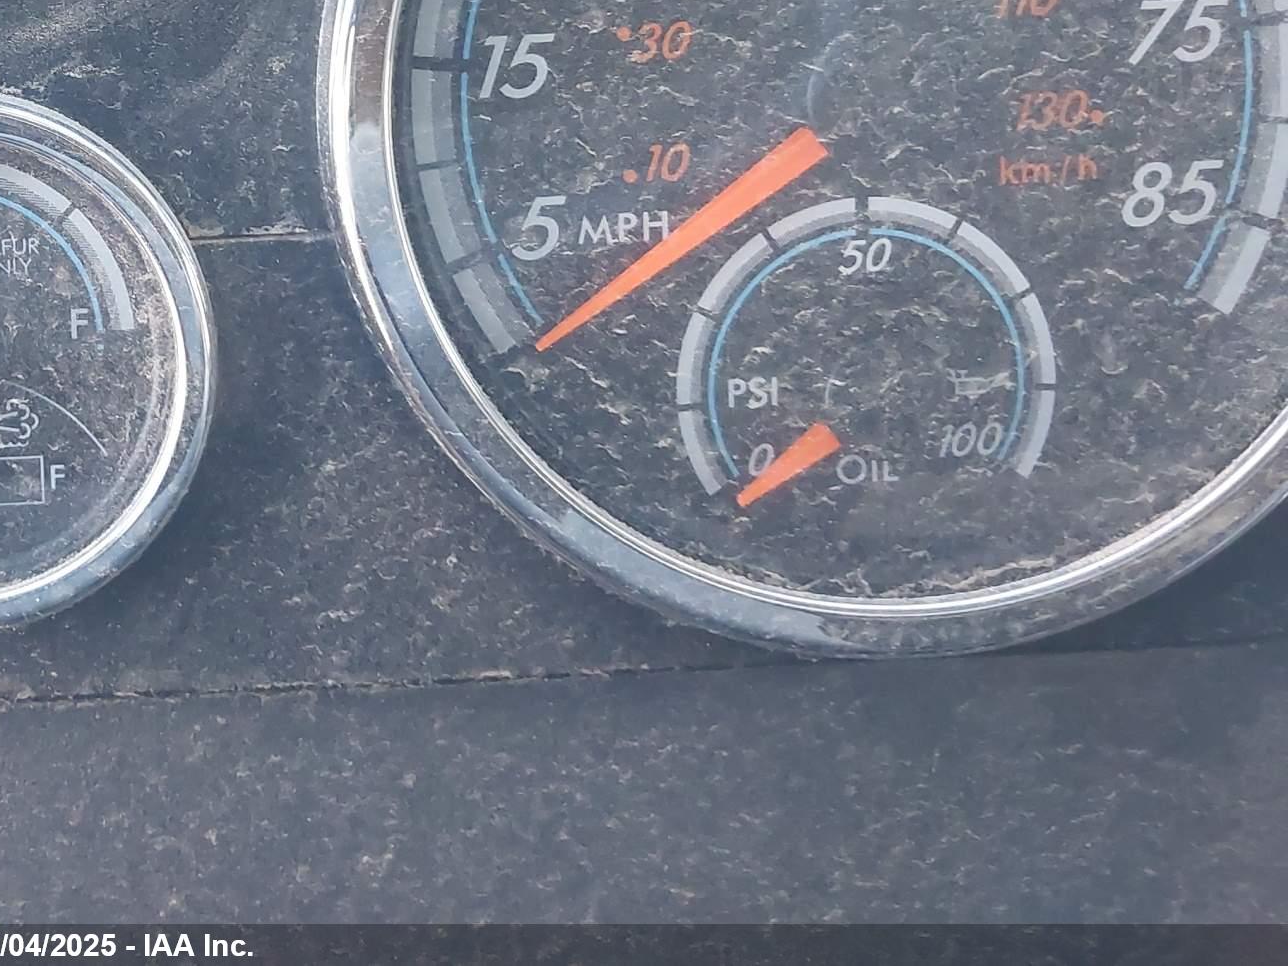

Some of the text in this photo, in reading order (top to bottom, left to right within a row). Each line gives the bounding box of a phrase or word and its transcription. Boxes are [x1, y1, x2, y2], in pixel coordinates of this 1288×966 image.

[629, 21, 692, 63] 30
[478, 33, 556, 100] 15
[1016, 89, 1090, 130] 130
[645, 144, 690, 183] 10
[999, 153, 1098, 185] km/h
[1122, 161, 1225, 228] 85
[512, 194, 568, 262] 5
[579, 210, 670, 247] MPH
[839, 238, 893, 275] 50
[71, 308, 88, 339] F
[727, 376, 779, 410] PSI
[939, 421, 1003, 458] 100
[50, 464, 66, 490] F
[748, 442, 775, 477] 0
[836, 454, 899, 485] OIL
